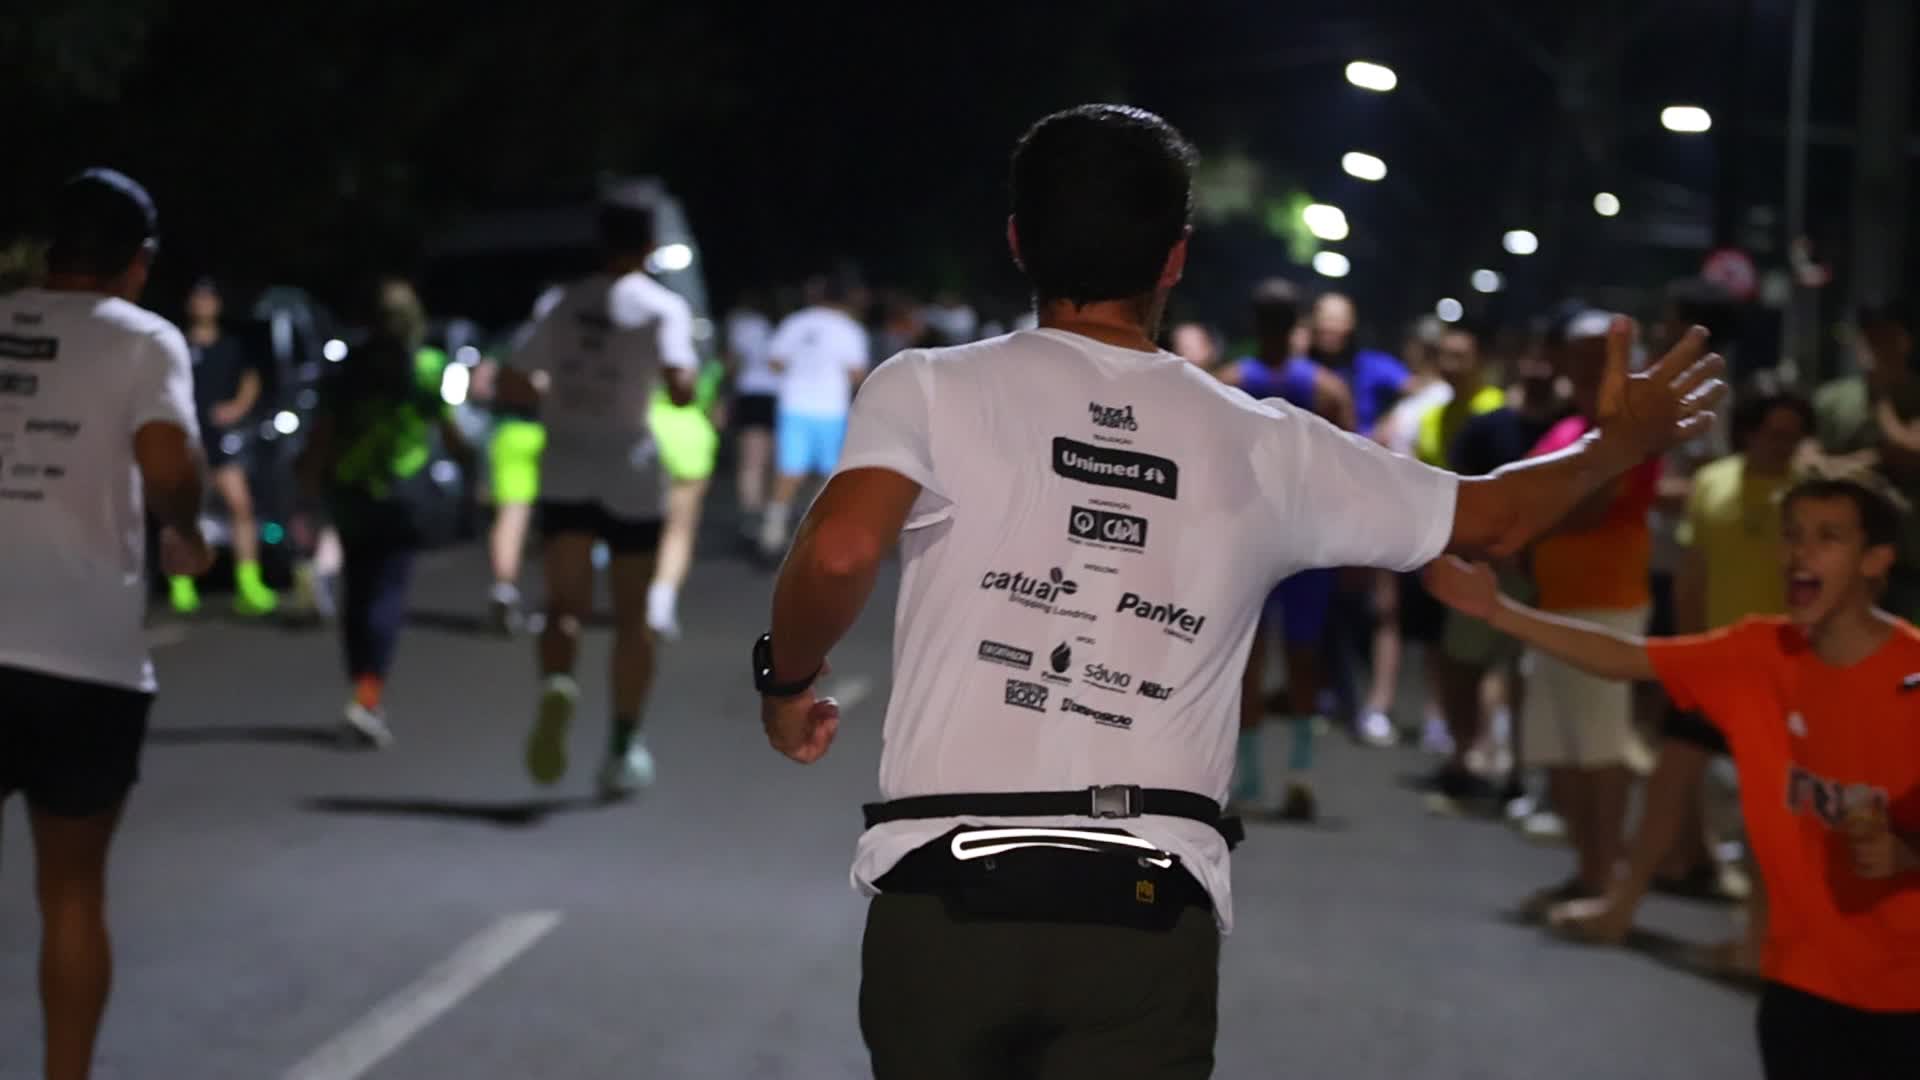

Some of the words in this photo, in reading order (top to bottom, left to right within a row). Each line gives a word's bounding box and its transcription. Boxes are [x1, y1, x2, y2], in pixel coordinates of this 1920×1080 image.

[1061, 450, 1140, 479] Unimed
[1104, 518, 1140, 543] CAPA
[1116, 592, 1206, 635] PanVel
